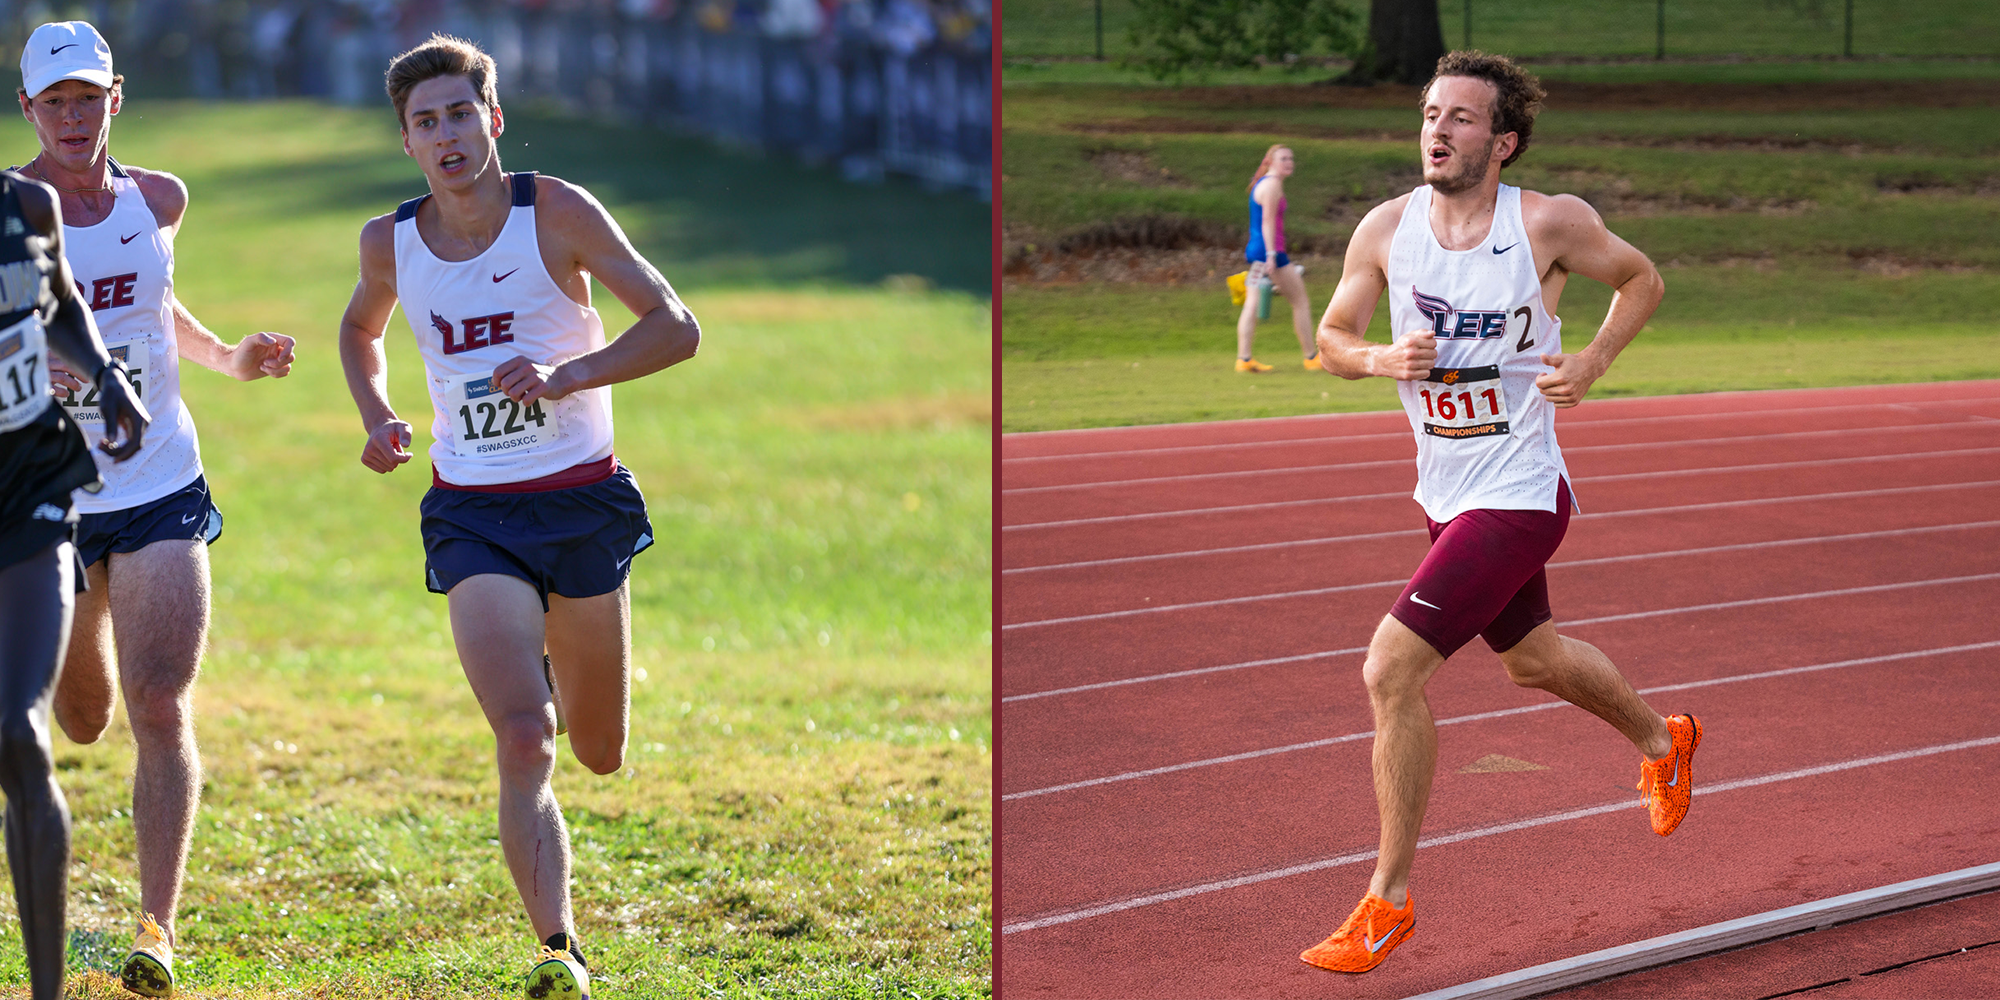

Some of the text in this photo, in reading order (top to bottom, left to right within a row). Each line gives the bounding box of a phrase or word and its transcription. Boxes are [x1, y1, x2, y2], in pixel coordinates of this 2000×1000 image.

[430, 309, 515, 355] LEE
[1420, 296, 1508, 341] LEE
[1514, 305, 1535, 353] 2
[459, 397, 547, 440] 1224
[1420, 388, 1500, 421] 1611
[476, 434, 538, 454] #SWAGSXCC
[1433, 424, 1497, 437] CHAMPIONSHIPS
